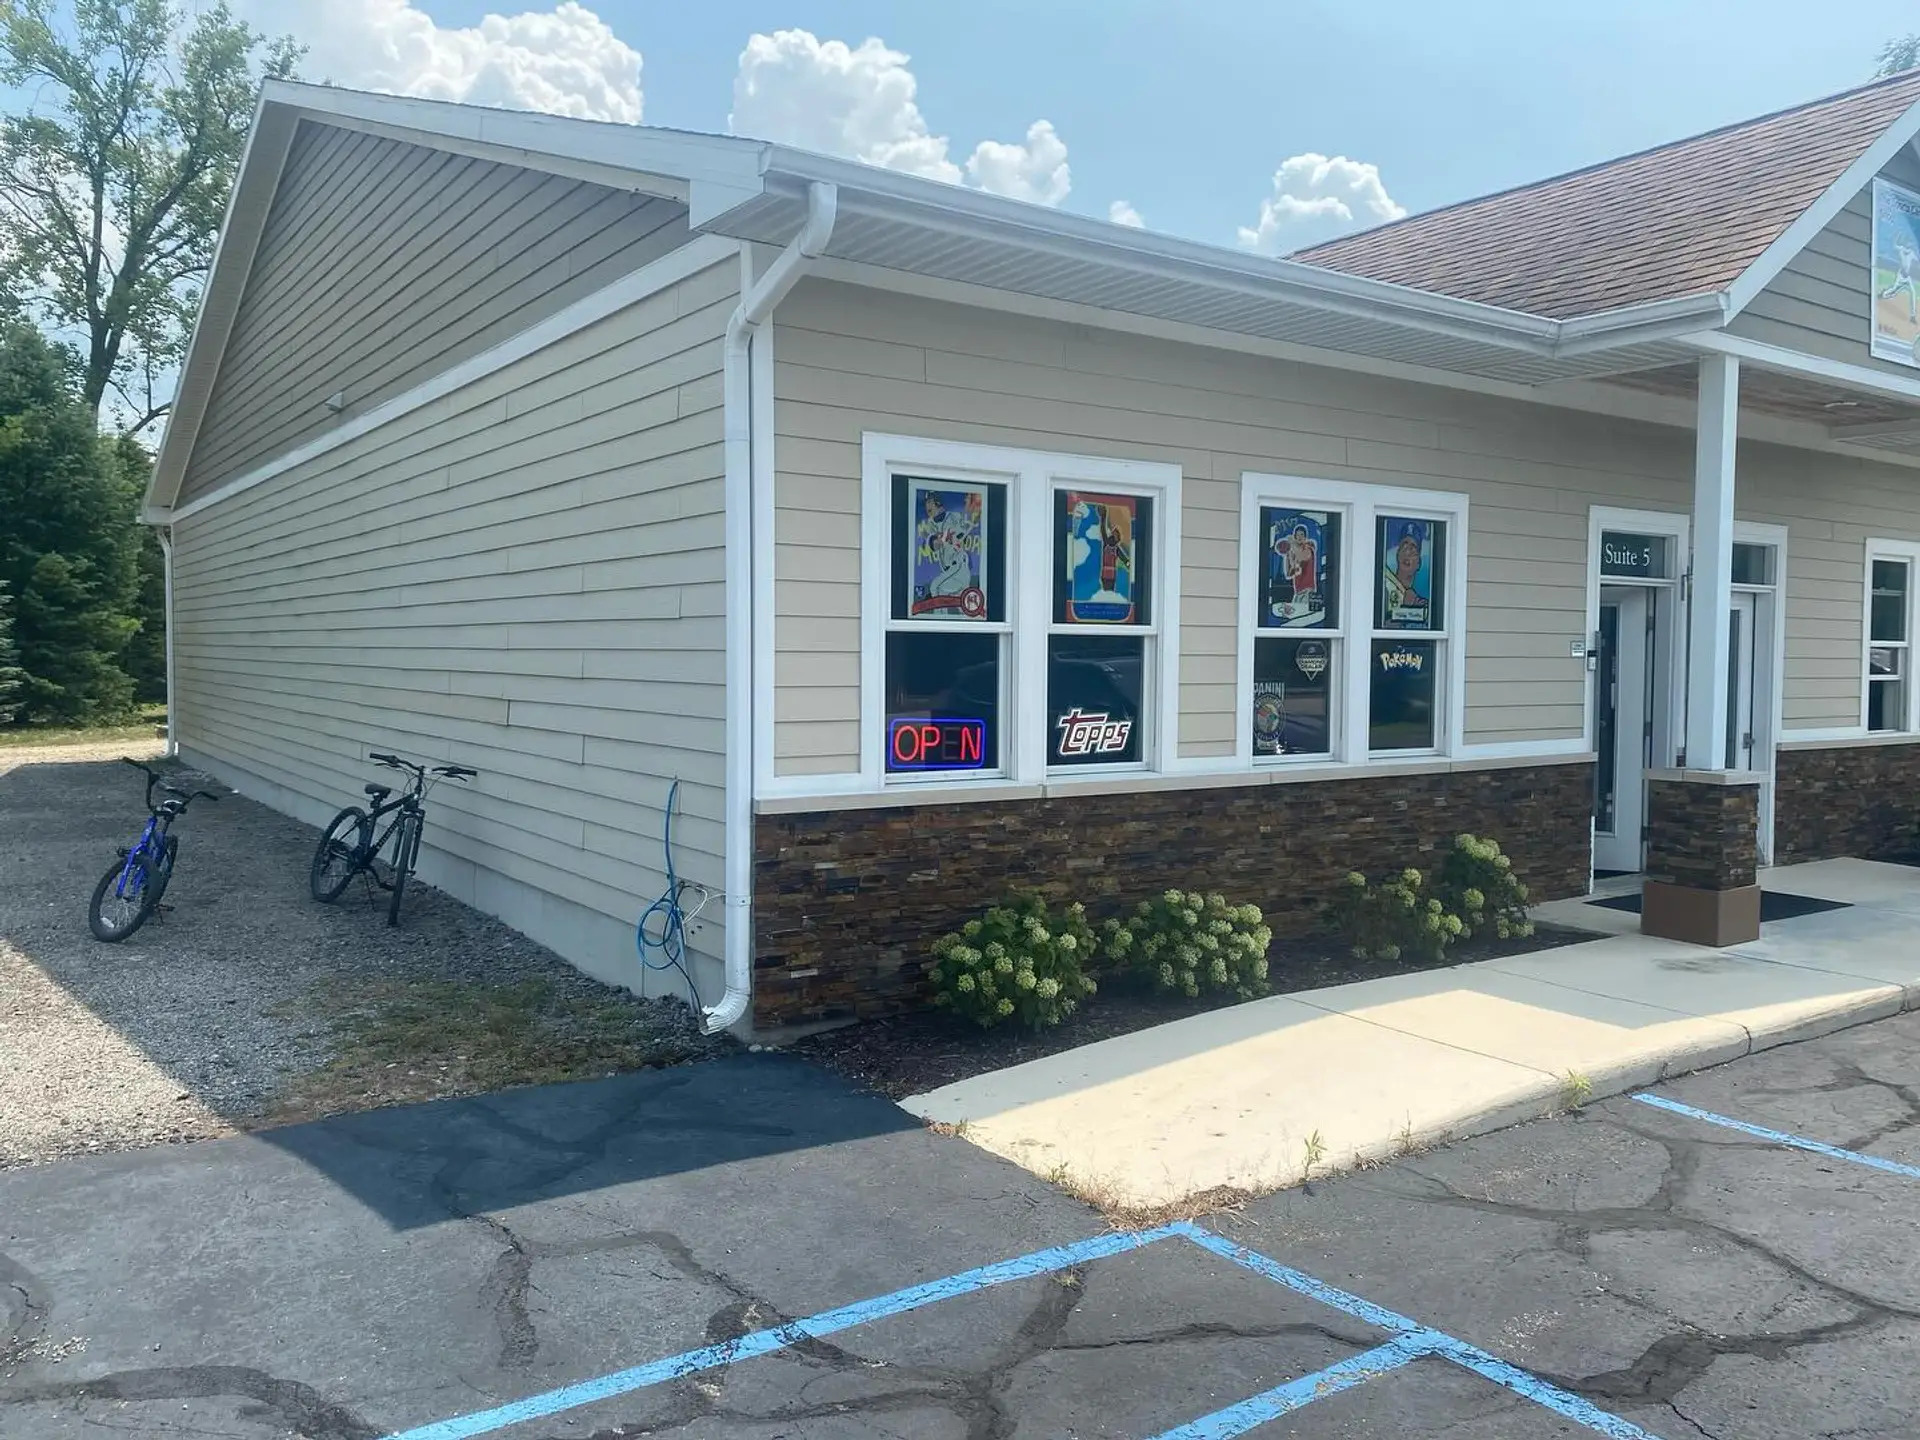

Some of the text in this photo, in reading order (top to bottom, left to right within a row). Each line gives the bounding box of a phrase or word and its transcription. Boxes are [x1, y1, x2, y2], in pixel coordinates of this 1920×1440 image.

[1605, 543, 1650, 567] Suite 5
[893, 725, 981, 761] OPEN
